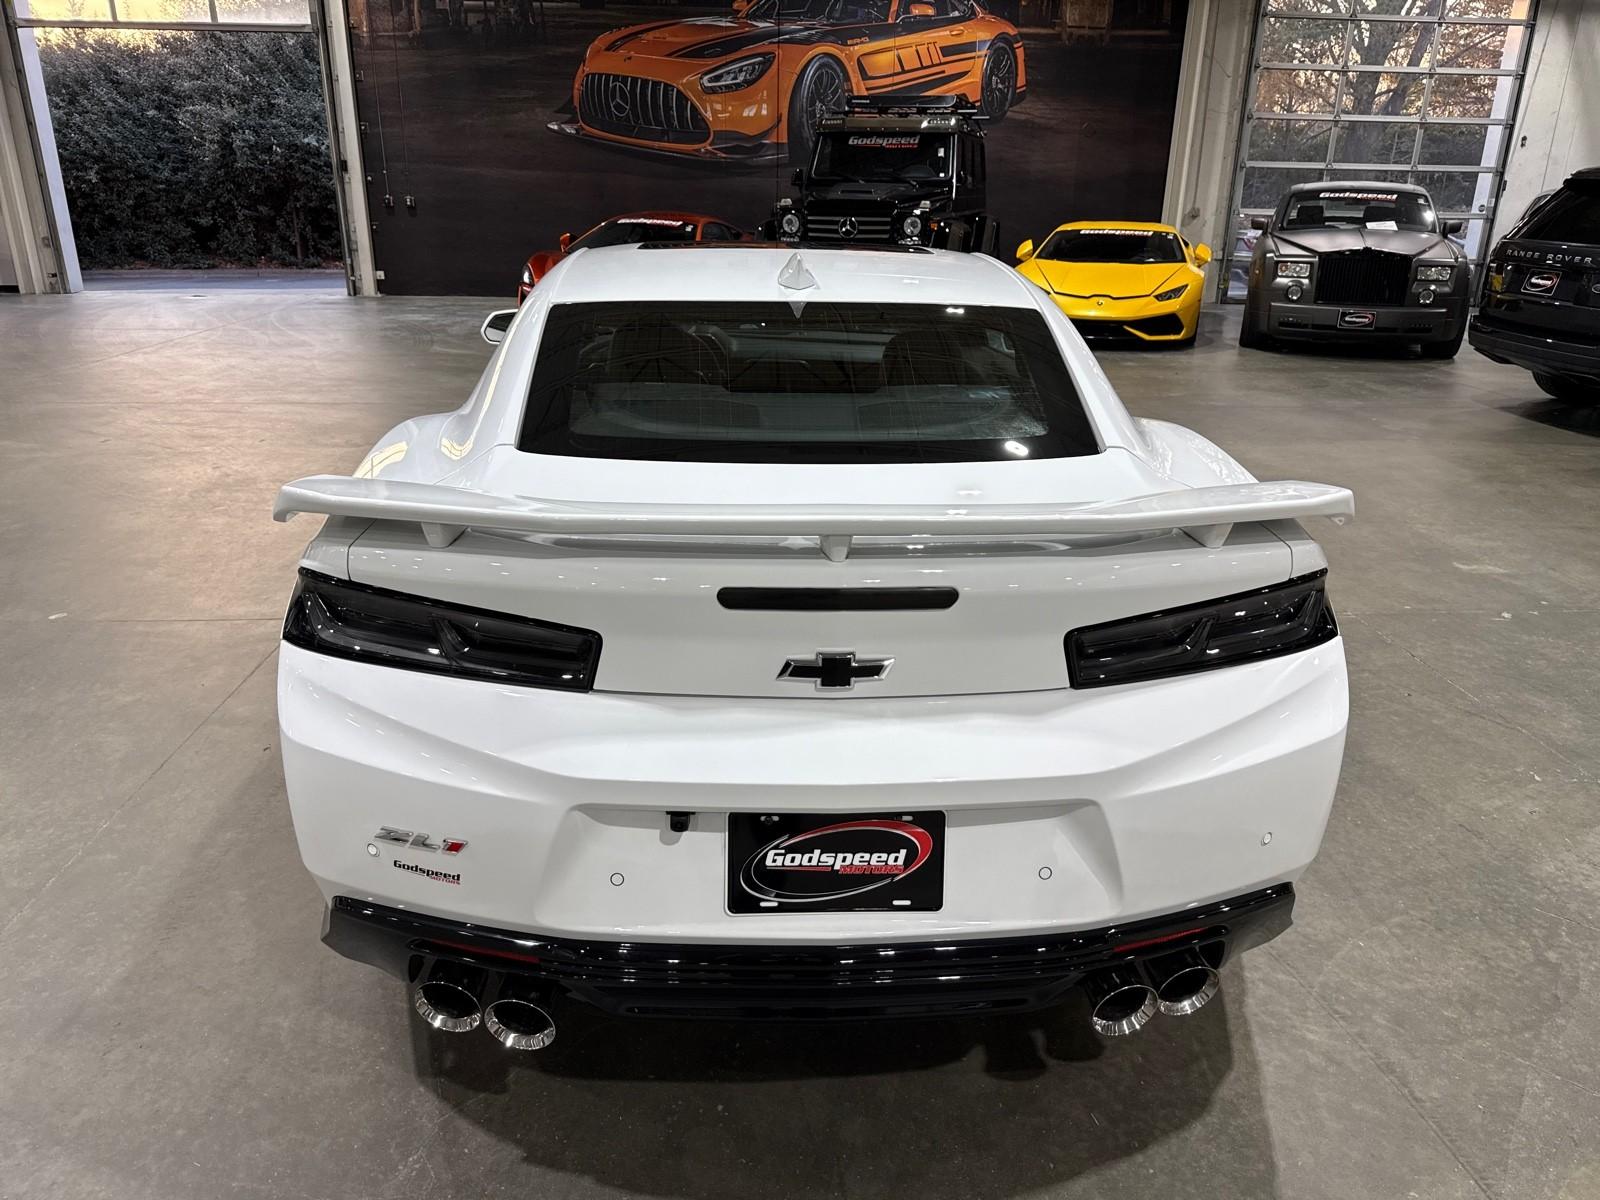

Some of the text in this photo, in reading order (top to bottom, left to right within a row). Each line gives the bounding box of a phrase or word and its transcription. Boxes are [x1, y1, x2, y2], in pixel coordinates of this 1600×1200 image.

[848, 135, 921, 147] Godspeed
[1319, 191, 1398, 200] Godspeed
[1505, 249, 1593, 264] RANGE ROVER
[374, 825, 468, 856] ZL1
[765, 848, 908, 870] Godspeed
[393, 859, 461, 882] Godspeed
[838, 864, 905, 875] MOTORS
[430, 874, 461, 886] MOTORS
